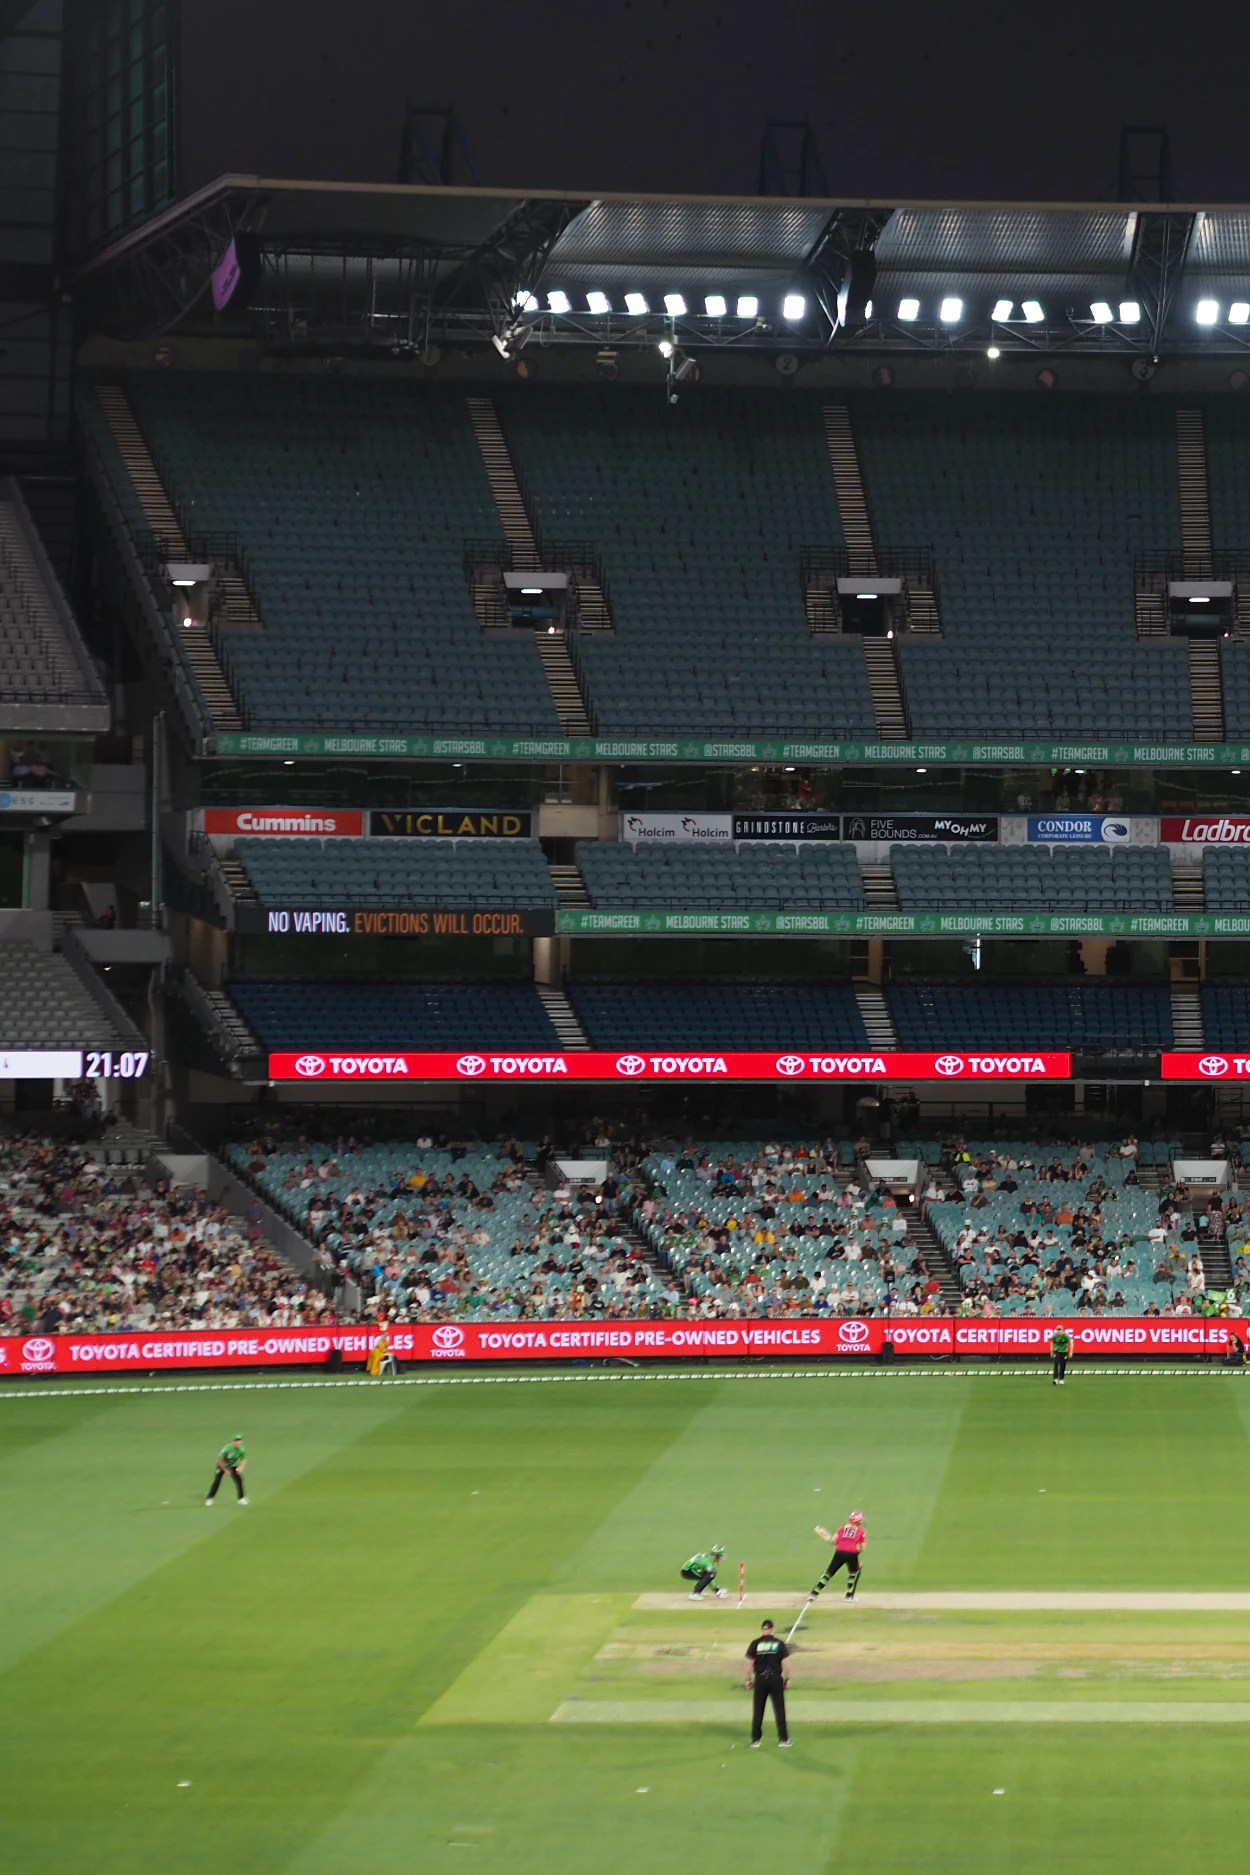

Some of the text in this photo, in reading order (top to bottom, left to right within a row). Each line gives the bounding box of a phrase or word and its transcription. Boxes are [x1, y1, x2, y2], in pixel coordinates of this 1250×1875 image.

[240, 737, 299, 751] #TEAMGREEN
[324, 738, 376, 753] MELBOURNE
[379, 738, 407, 753] STARS
[433, 740, 486, 754] @STARSBBL
[512, 741, 570, 755] #TEAMGREEN
[595, 742, 647, 757] MELBOURNE
[650, 742, 678, 757] STARS
[703, 743, 757, 757] @STARSBBL
[782, 744, 840, 758] #TEAMGREEN
[864, 745, 916, 759] MELBOURNE
[919, 745, 947, 759] STARS
[972, 746, 1025, 760] @STARSBBL
[1050, 747, 1109, 761] #TEAMGREEN
[1133, 747, 1184, 761] MELBOURNE
[1187, 747, 1215, 761] STARS
[236, 813, 336, 831] Cummins
[381, 814, 521, 835] VICLAND
[735, 821, 805, 834] GRINDSTONE
[870, 820, 894, 829] FIVE
[934, 820, 952, 830] MY
[951, 823, 969, 837] OH
[969, 823, 987, 833] MY
[1037, 820, 1092, 833] CONDOR
[638, 827, 675, 837] Holcim
[692, 828, 729, 838] Holcim
[870, 829, 917, 839] BOUNDS
[268, 911, 524, 934] NO VAPING. EVICTIONS WILL OCCUR.
[580, 914, 641, 929] #TEAMGREEN
[665, 915, 718, 929] MELBOURNE
[721, 915, 750, 929] STARS
[775, 915, 830, 930] @STARSBBL
[855, 916, 915, 931] #TEAMGREEN
[940, 916, 993, 931] MELBOURNE
[996, 916, 1025, 931] STARS
[1050, 917, 1105, 932] @STARSBBL
[1130, 917, 1189, 932] #TEAMGREEN
[85, 1051, 149, 1078] 21:07
[330, 1058, 1045, 1073] TOYOTA TOYOTA TOYOTA TOYOTA TOYOTA
[1226, 1289, 1236, 1300] 6
[478, 1330, 820, 1348] TOYOTA CERTIFIED PRE-OWNED VEHICLES
[884, 1328, 1228, 1343] TOYOTA CERTIFIED PE-OWNED VEHICLES
[70, 1344, 138, 1361] TOYOTA
[142, 1341, 224, 1358] CERTIFIED
[227, 1337, 330, 1355] PRE-OWNED
[431, 1348, 465, 1358] TOYOTA
[836, 1344, 870, 1352] TOYOTA
